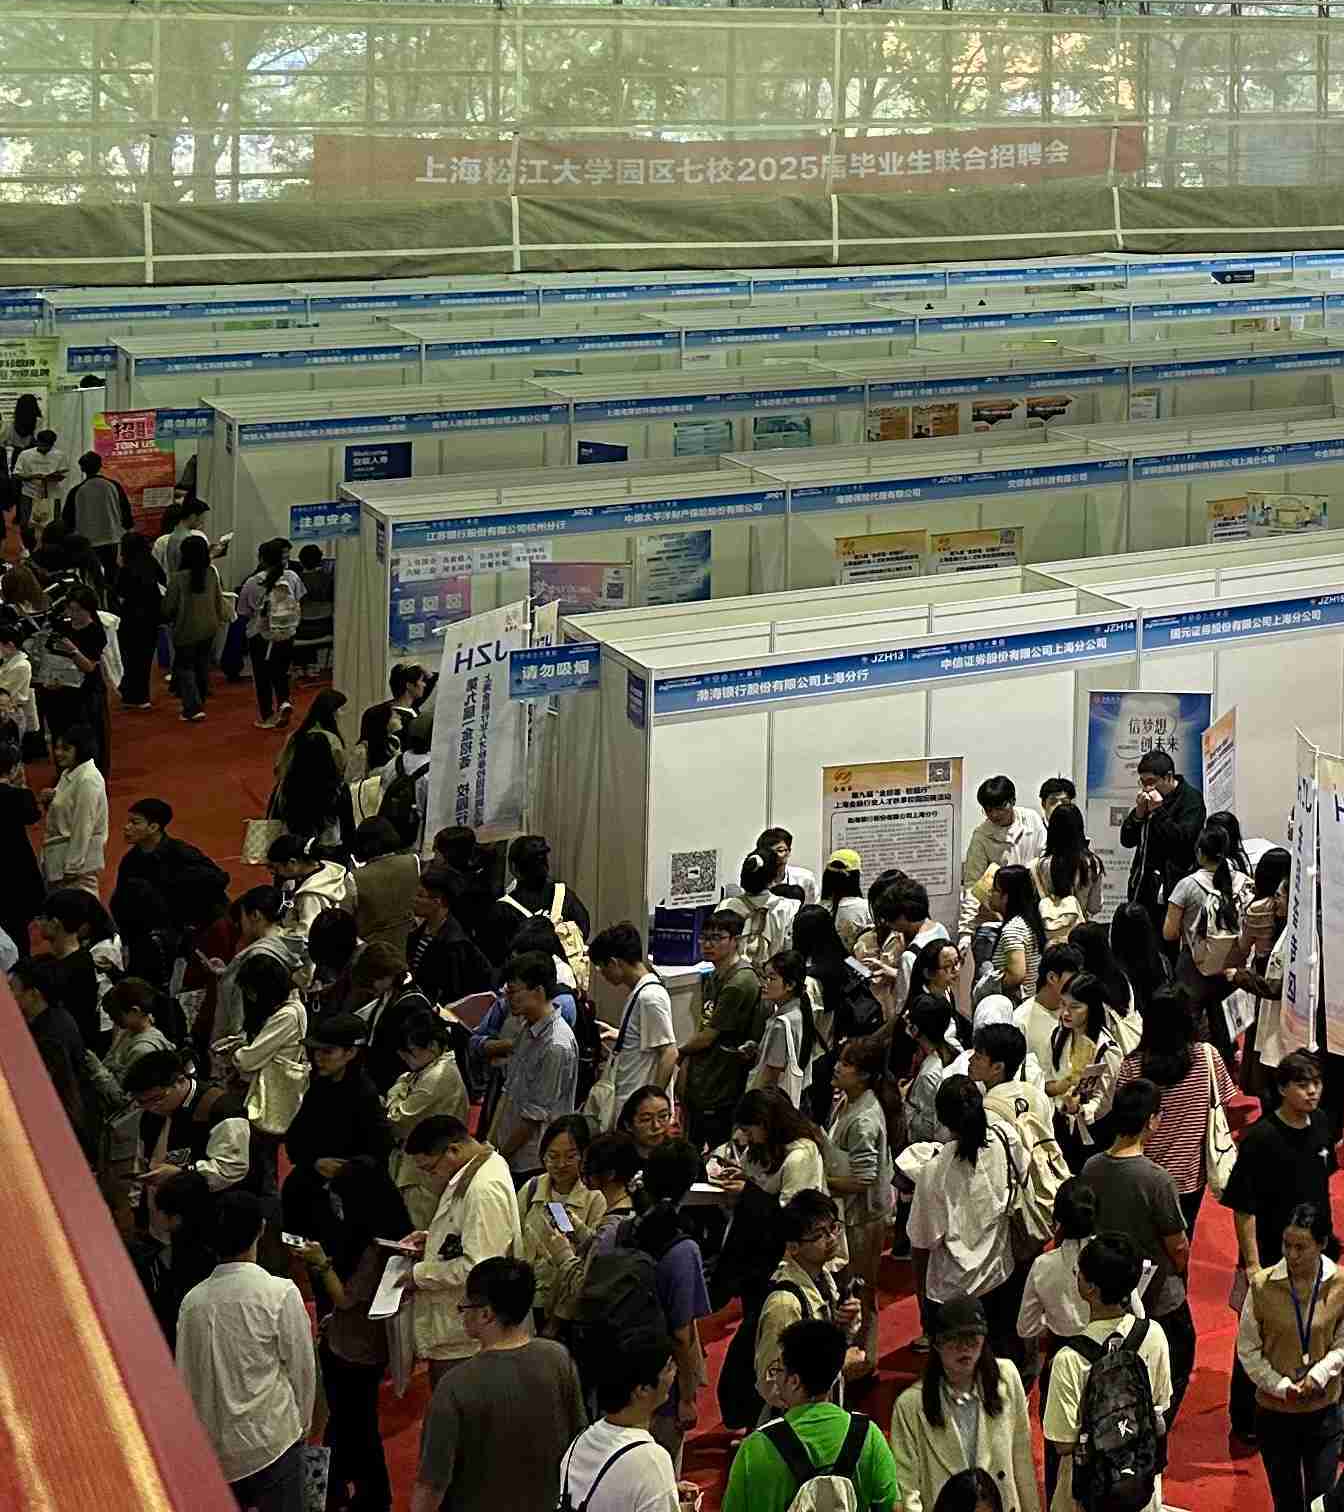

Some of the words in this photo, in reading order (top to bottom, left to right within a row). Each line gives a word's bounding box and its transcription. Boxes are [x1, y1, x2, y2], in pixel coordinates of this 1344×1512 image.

[1104, 623, 1134, 635] JZH14
[871, 652, 905, 665] JZH13
[941, 637, 1108, 669] 中信证券股份有限公司上海分公司
[521, 660, 590, 682] 请勿吸烟
[1129, 717, 1168, 736] 信梦想
[1141, 736, 1179, 754] 创未来
